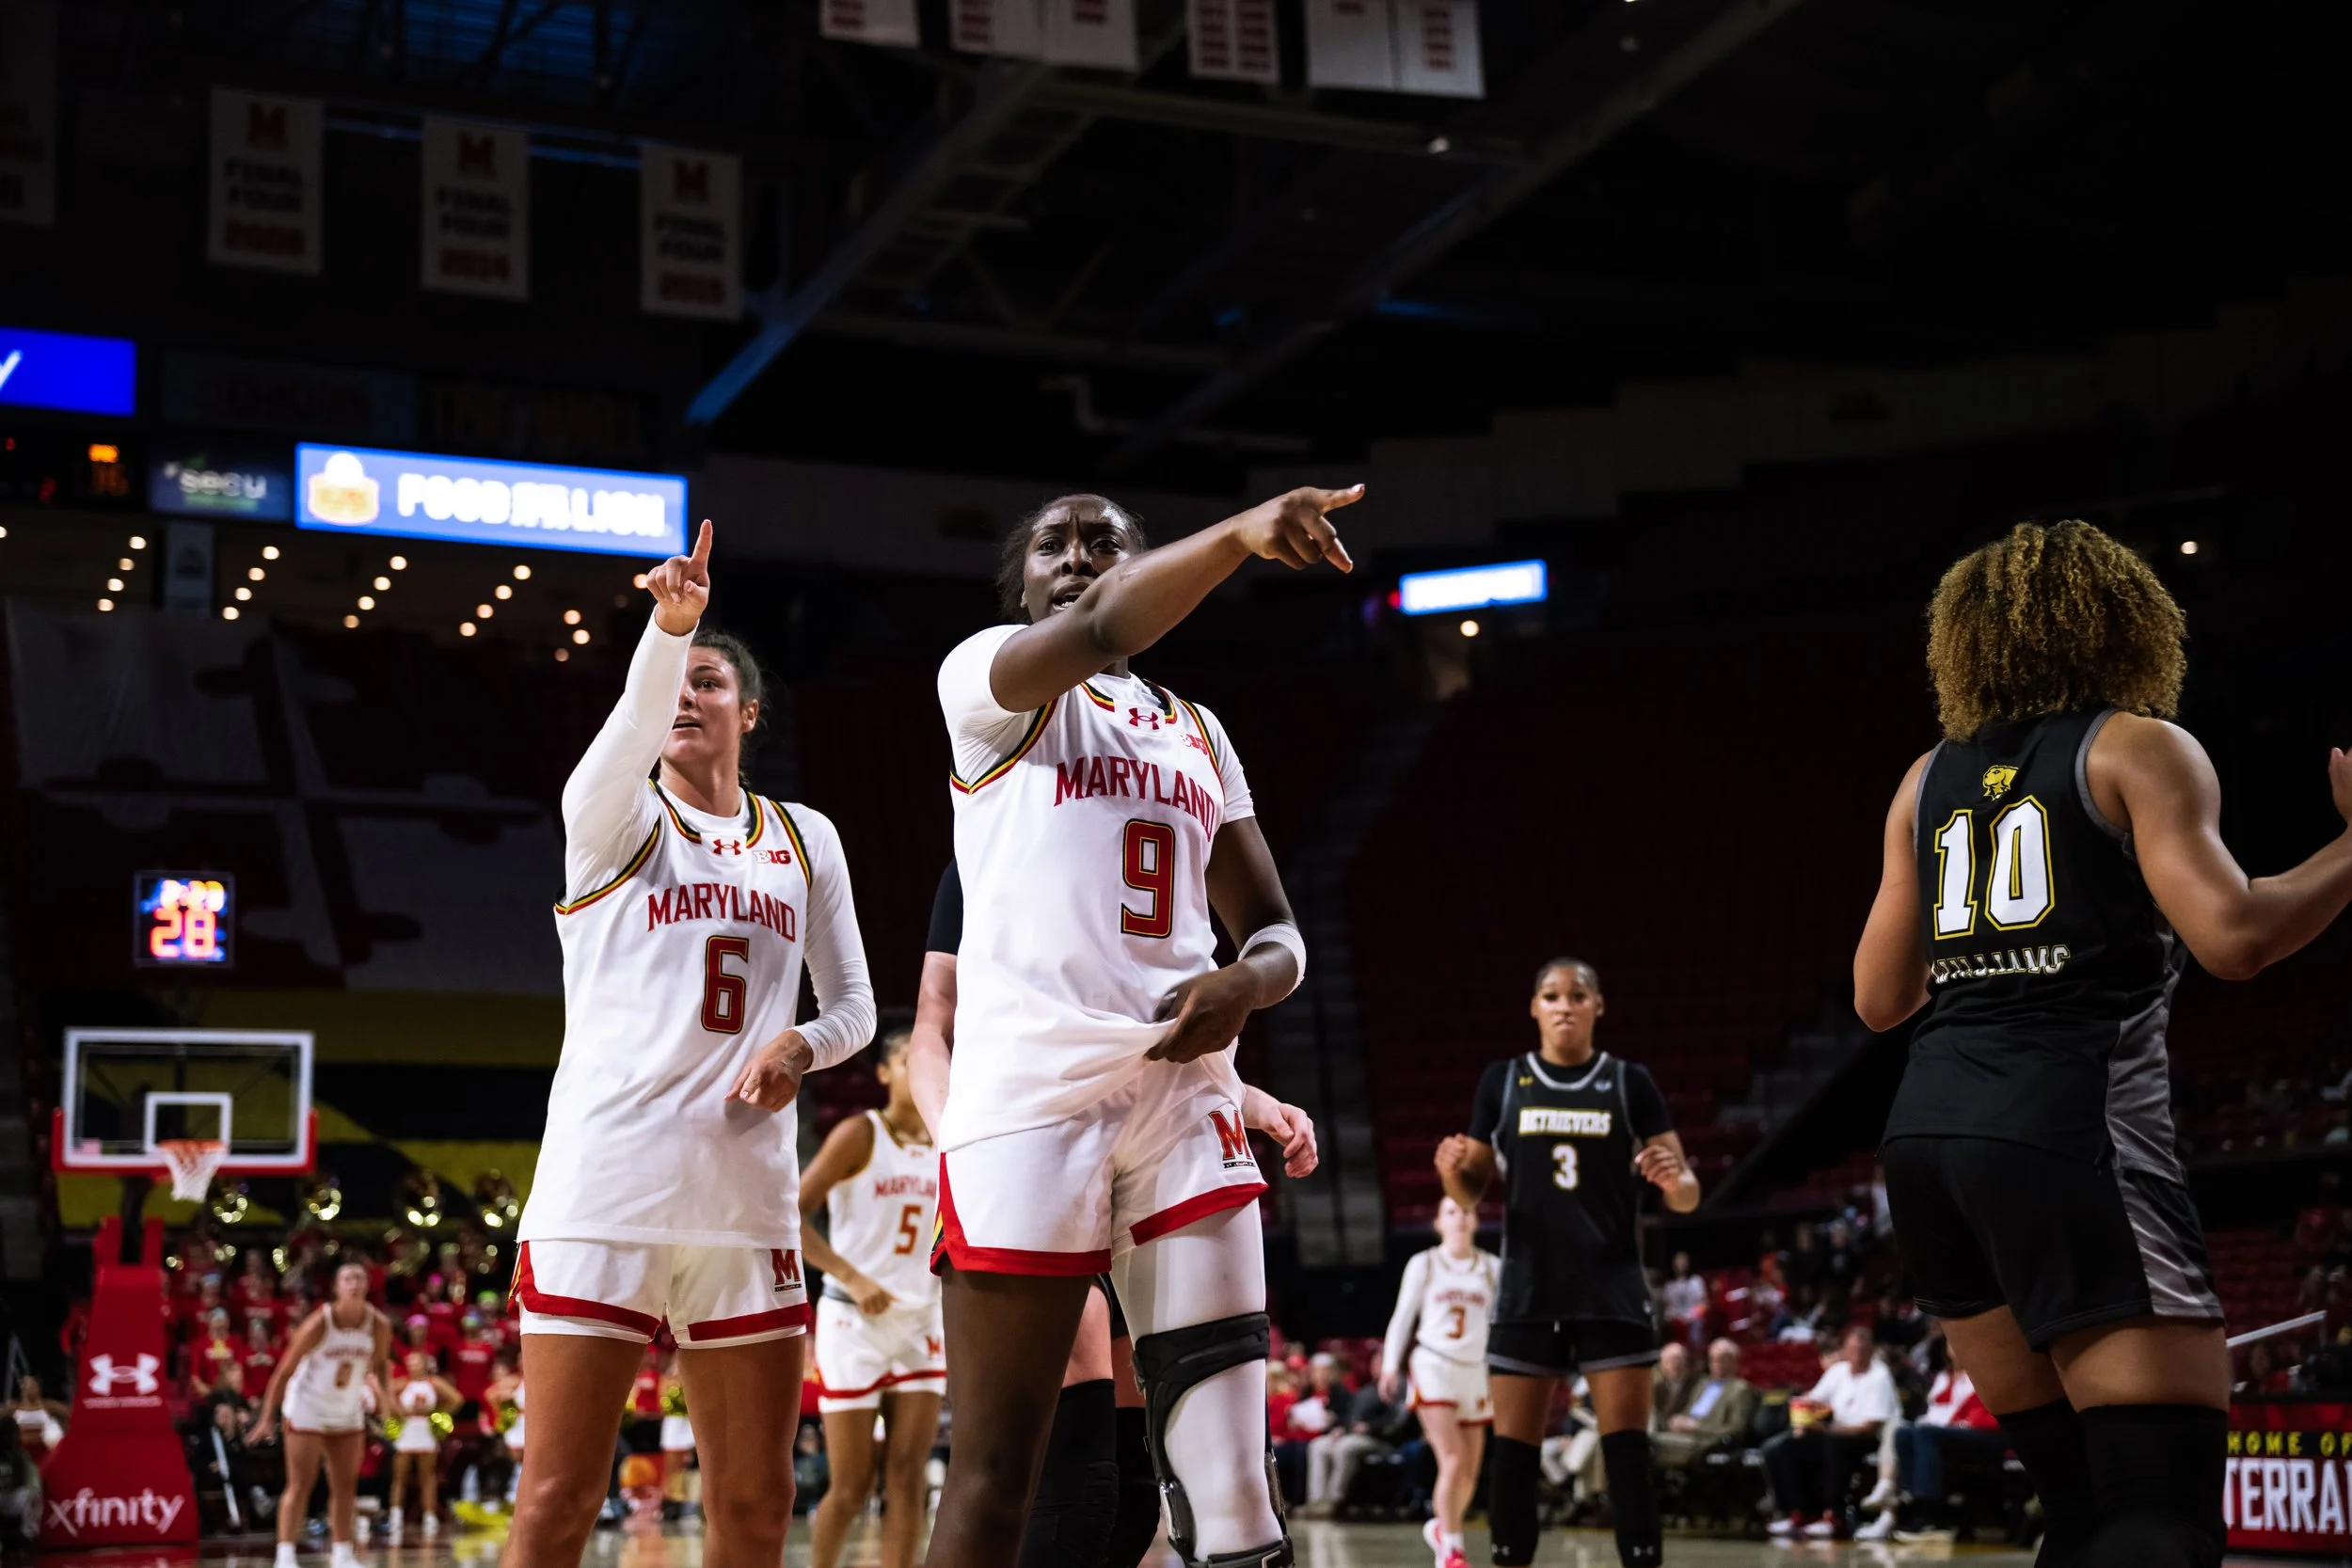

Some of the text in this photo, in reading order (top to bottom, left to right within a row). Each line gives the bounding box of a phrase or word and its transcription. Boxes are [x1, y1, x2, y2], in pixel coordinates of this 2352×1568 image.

[1054, 756, 1216, 843] MARYLAND
[1120, 818, 1176, 939] 9
[1933, 794, 2056, 941] 10
[150, 907, 216, 958] 28
[647, 883, 796, 942] MARYLAND
[701, 934, 750, 1036] 6
[1208, 1110, 1252, 1161] M
[1551, 1142, 1579, 1192] 3
[894, 1204, 924, 1256] 5
[770, 1248, 802, 1286] M
[2227, 1431, 2302, 1457] HOME
[46, 1487, 185, 1538] xfinity
